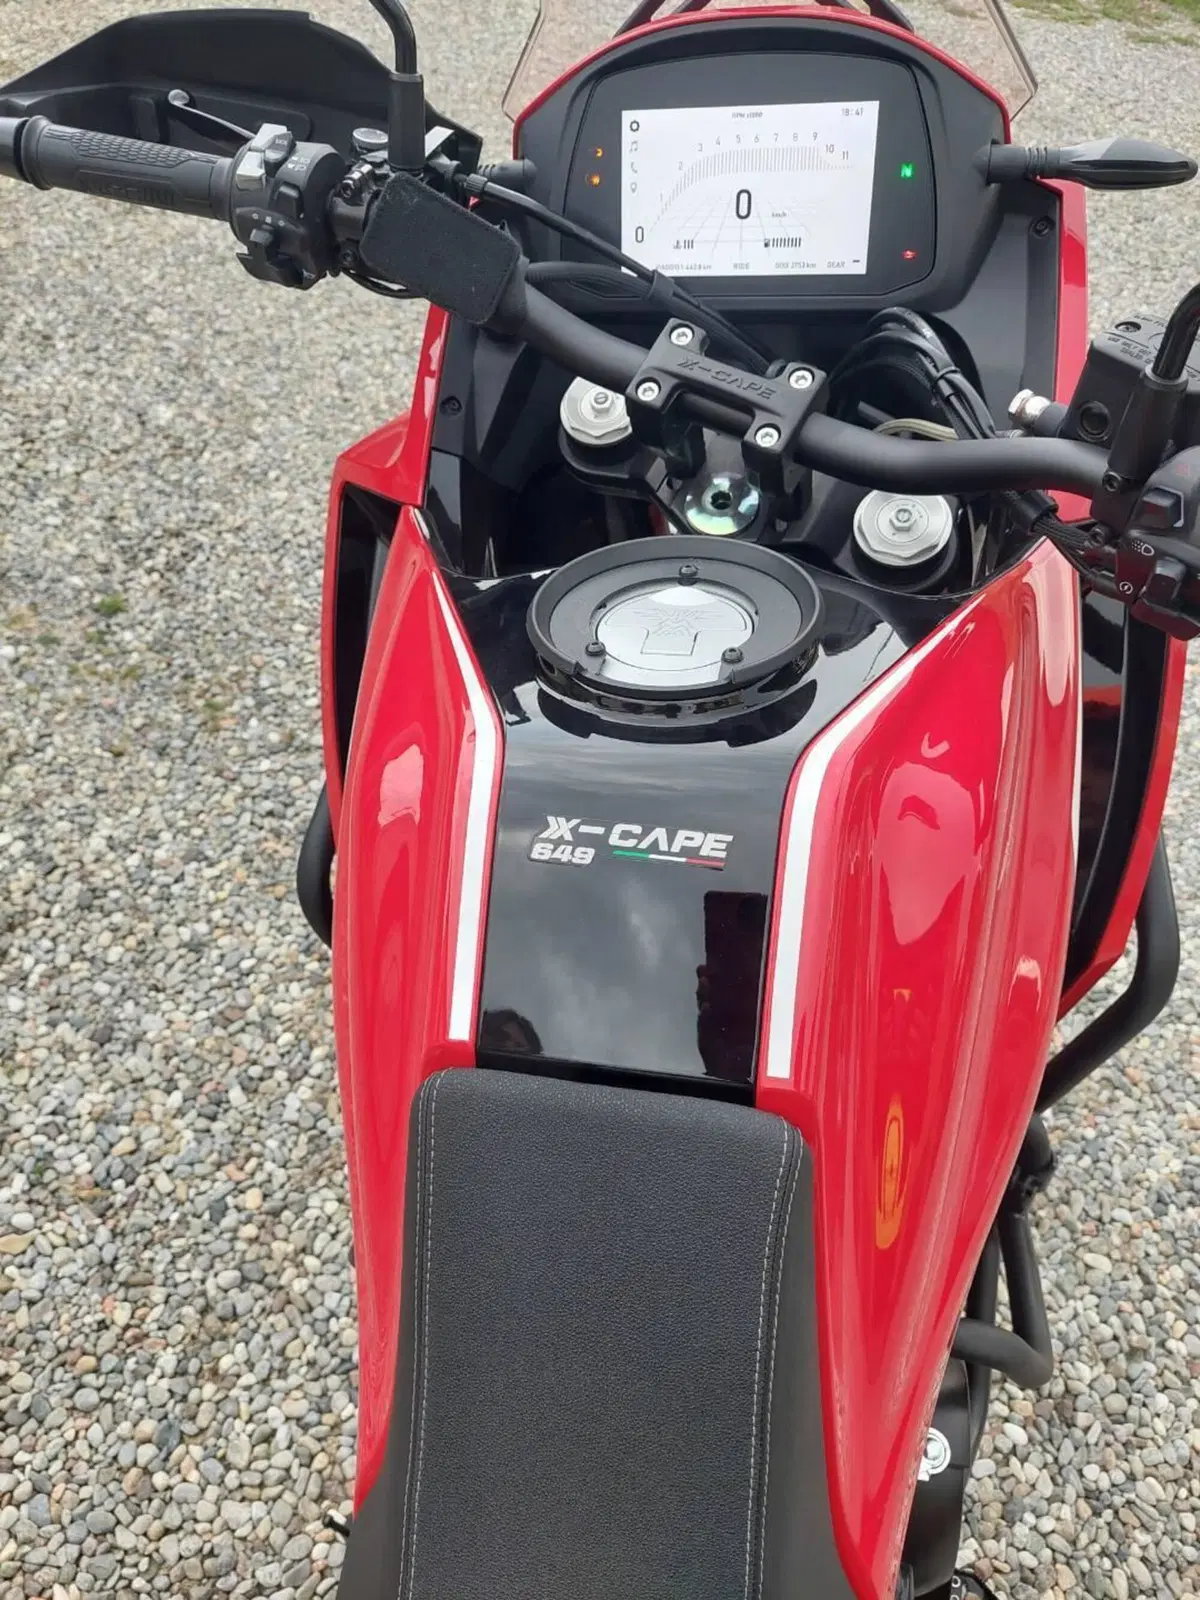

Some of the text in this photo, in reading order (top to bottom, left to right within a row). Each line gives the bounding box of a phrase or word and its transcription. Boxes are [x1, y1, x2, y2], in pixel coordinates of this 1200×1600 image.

[841, 107, 864, 117] 18:41
[677, 161, 684, 171] 2
[697, 143, 703, 152] 3
[715, 137, 721, 146] 4
[735, 134, 741, 144] 5
[753, 133, 760, 143] 6
[773, 133, 780, 143] 7
[792, 132, 799, 142] 8
[812, 131, 818, 142] 9
[825, 143, 835, 154] 10
[842, 150, 849, 161] 11
[735, 188, 752, 220] 0
[635, 225, 645, 243] 0
[827, 260, 846, 268] GEAR
[677, 356, 777, 400] X-CAPE
[538, 816, 733, 858] X-CAPE
[530, 842, 596, 865] 649
